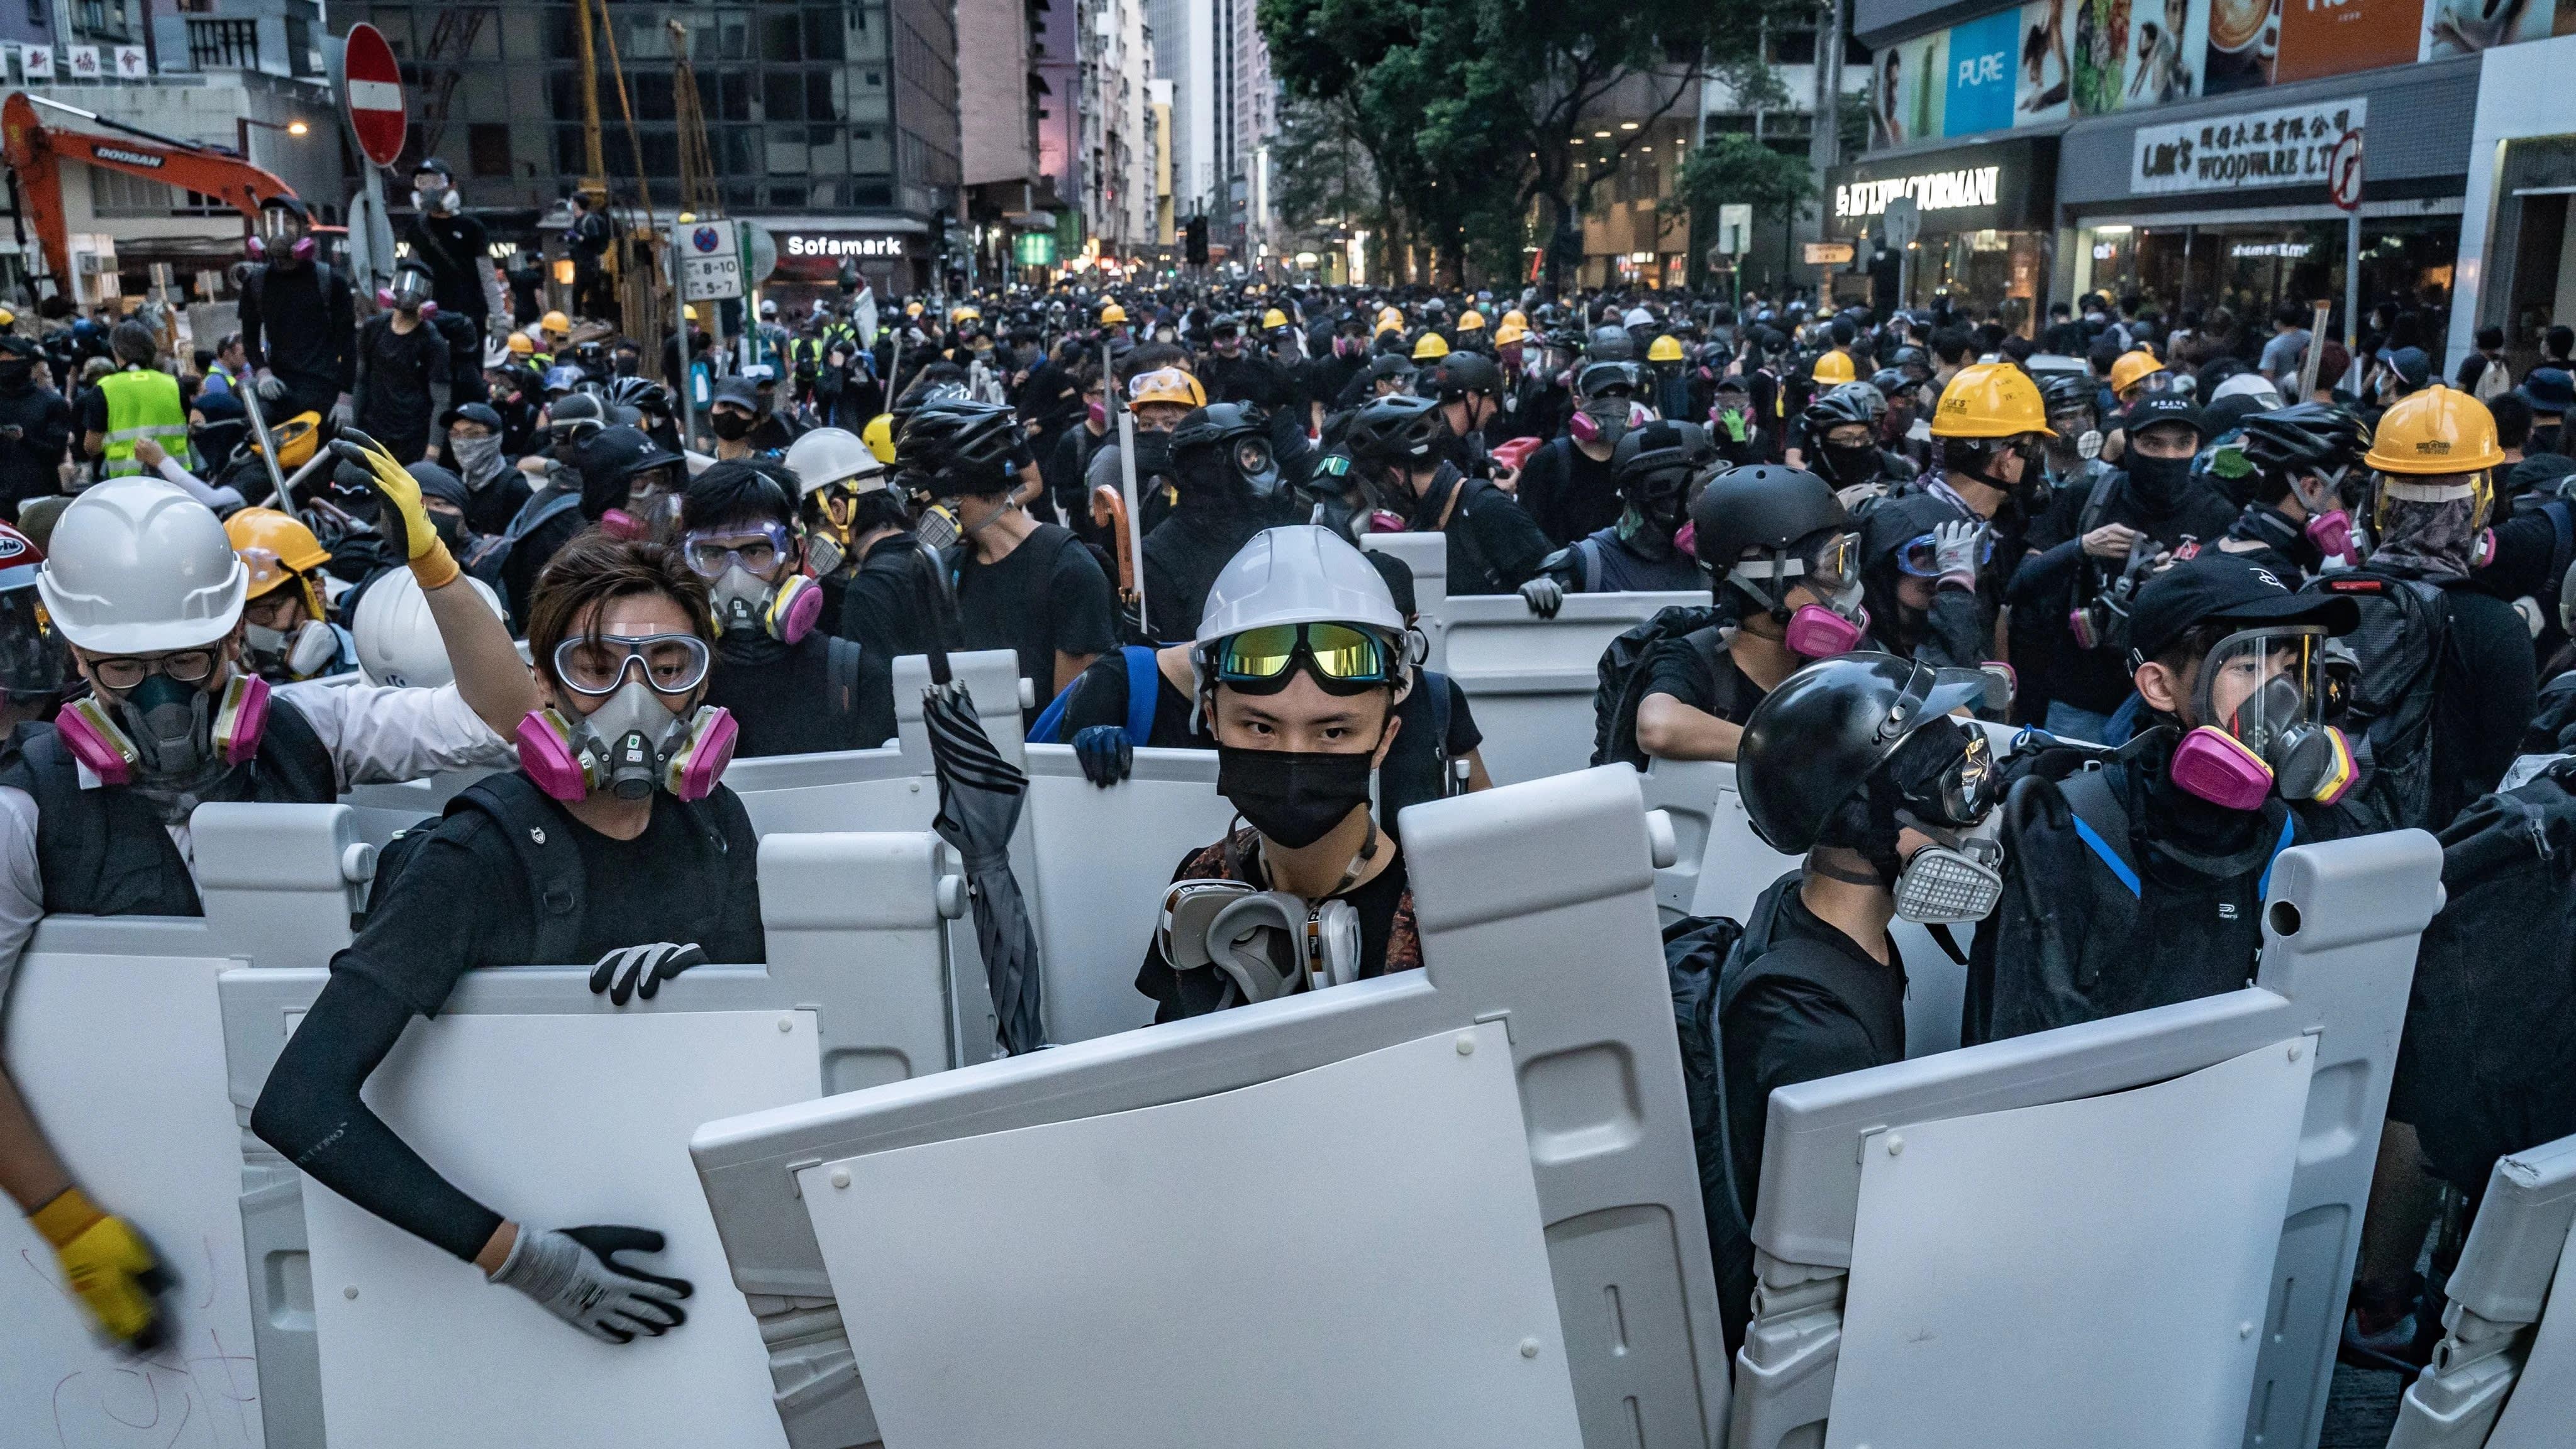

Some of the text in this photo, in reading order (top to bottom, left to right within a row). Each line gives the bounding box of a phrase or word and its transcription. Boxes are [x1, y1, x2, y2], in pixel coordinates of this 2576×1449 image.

[1958, 52, 2005, 88] PURE
[96, 147, 162, 167] DOOSAN
[2198, 143, 2335, 180] WOODWARE LT
[788, 236, 902, 255] Sofamark
